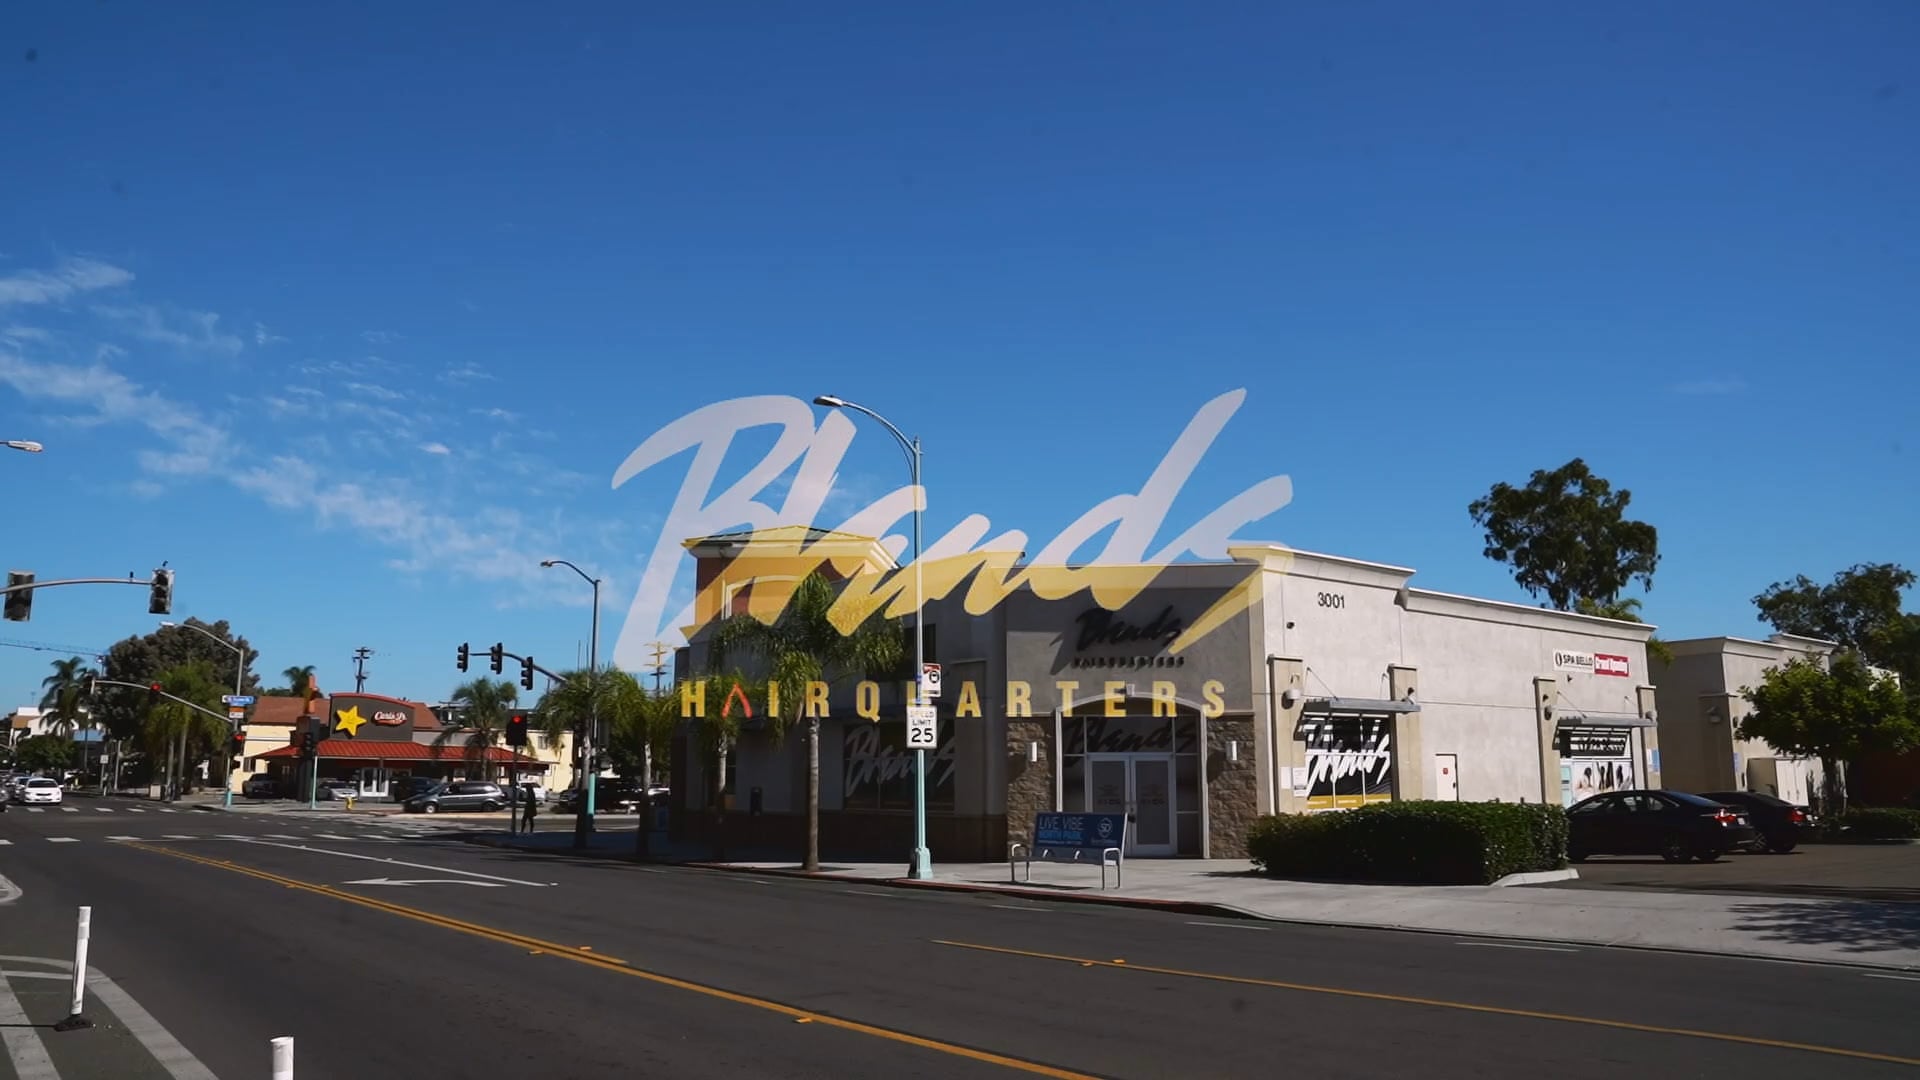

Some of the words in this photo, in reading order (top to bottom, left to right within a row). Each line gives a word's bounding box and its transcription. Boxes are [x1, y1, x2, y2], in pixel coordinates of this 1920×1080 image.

[1318, 592, 1345, 609] 3001
[1563, 654, 1575, 664] SPA
[911, 728, 934, 743] 25
[1039, 816, 1060, 830] LIVE
[1062, 816, 1084, 831] VIBE
